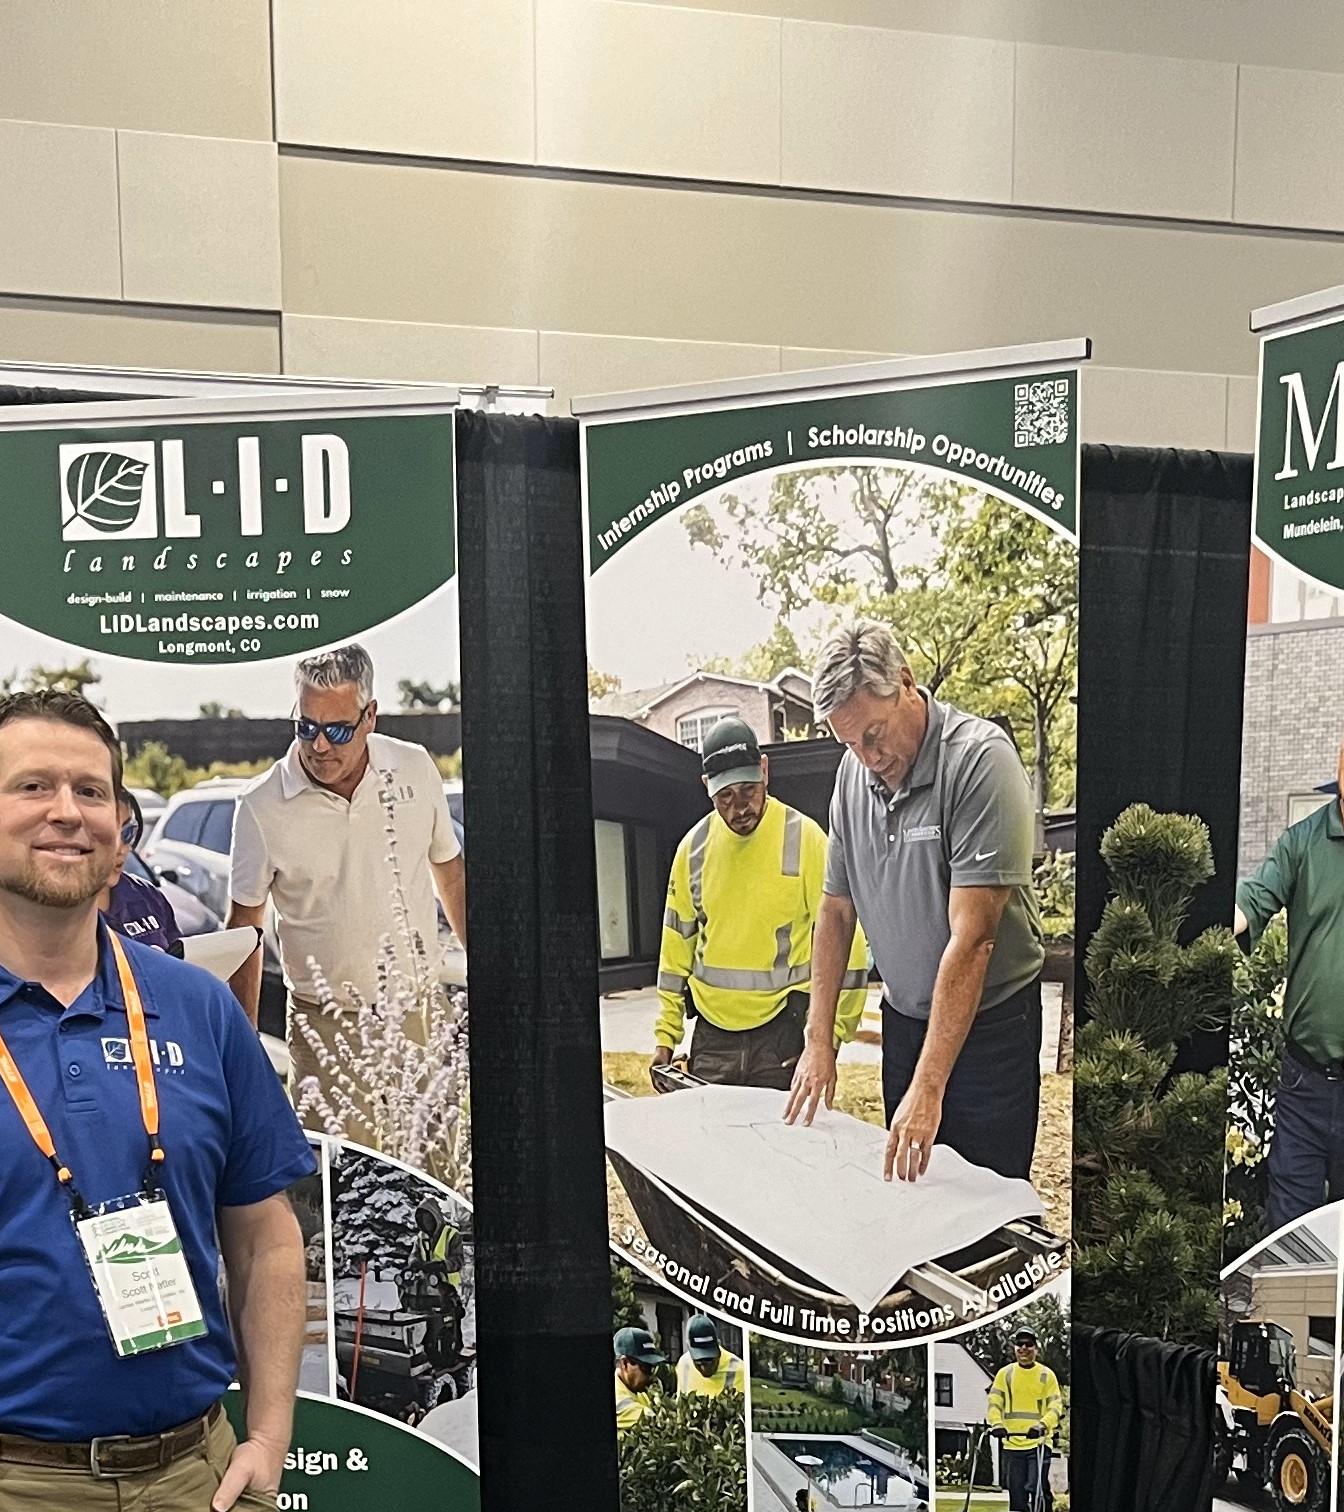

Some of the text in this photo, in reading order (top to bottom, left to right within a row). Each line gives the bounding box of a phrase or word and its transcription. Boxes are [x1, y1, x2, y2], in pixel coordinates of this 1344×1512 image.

[597, 426, 1064, 551] Internship Programs Scholarship Opportunities
[1283, 516, 1344, 540] Mundelein,
[63, 545, 352, 574] landscapes
[67, 588, 350, 606] design-build maintenance irrigation snow
[100, 612, 320, 635] LIDLandscapes.com
[159, 638, 261, 656] Longmont, CO
[622, 1225, 1062, 1336] Seasonal and Full Time Positions Available
[346, 1448, 369, 1471] &
